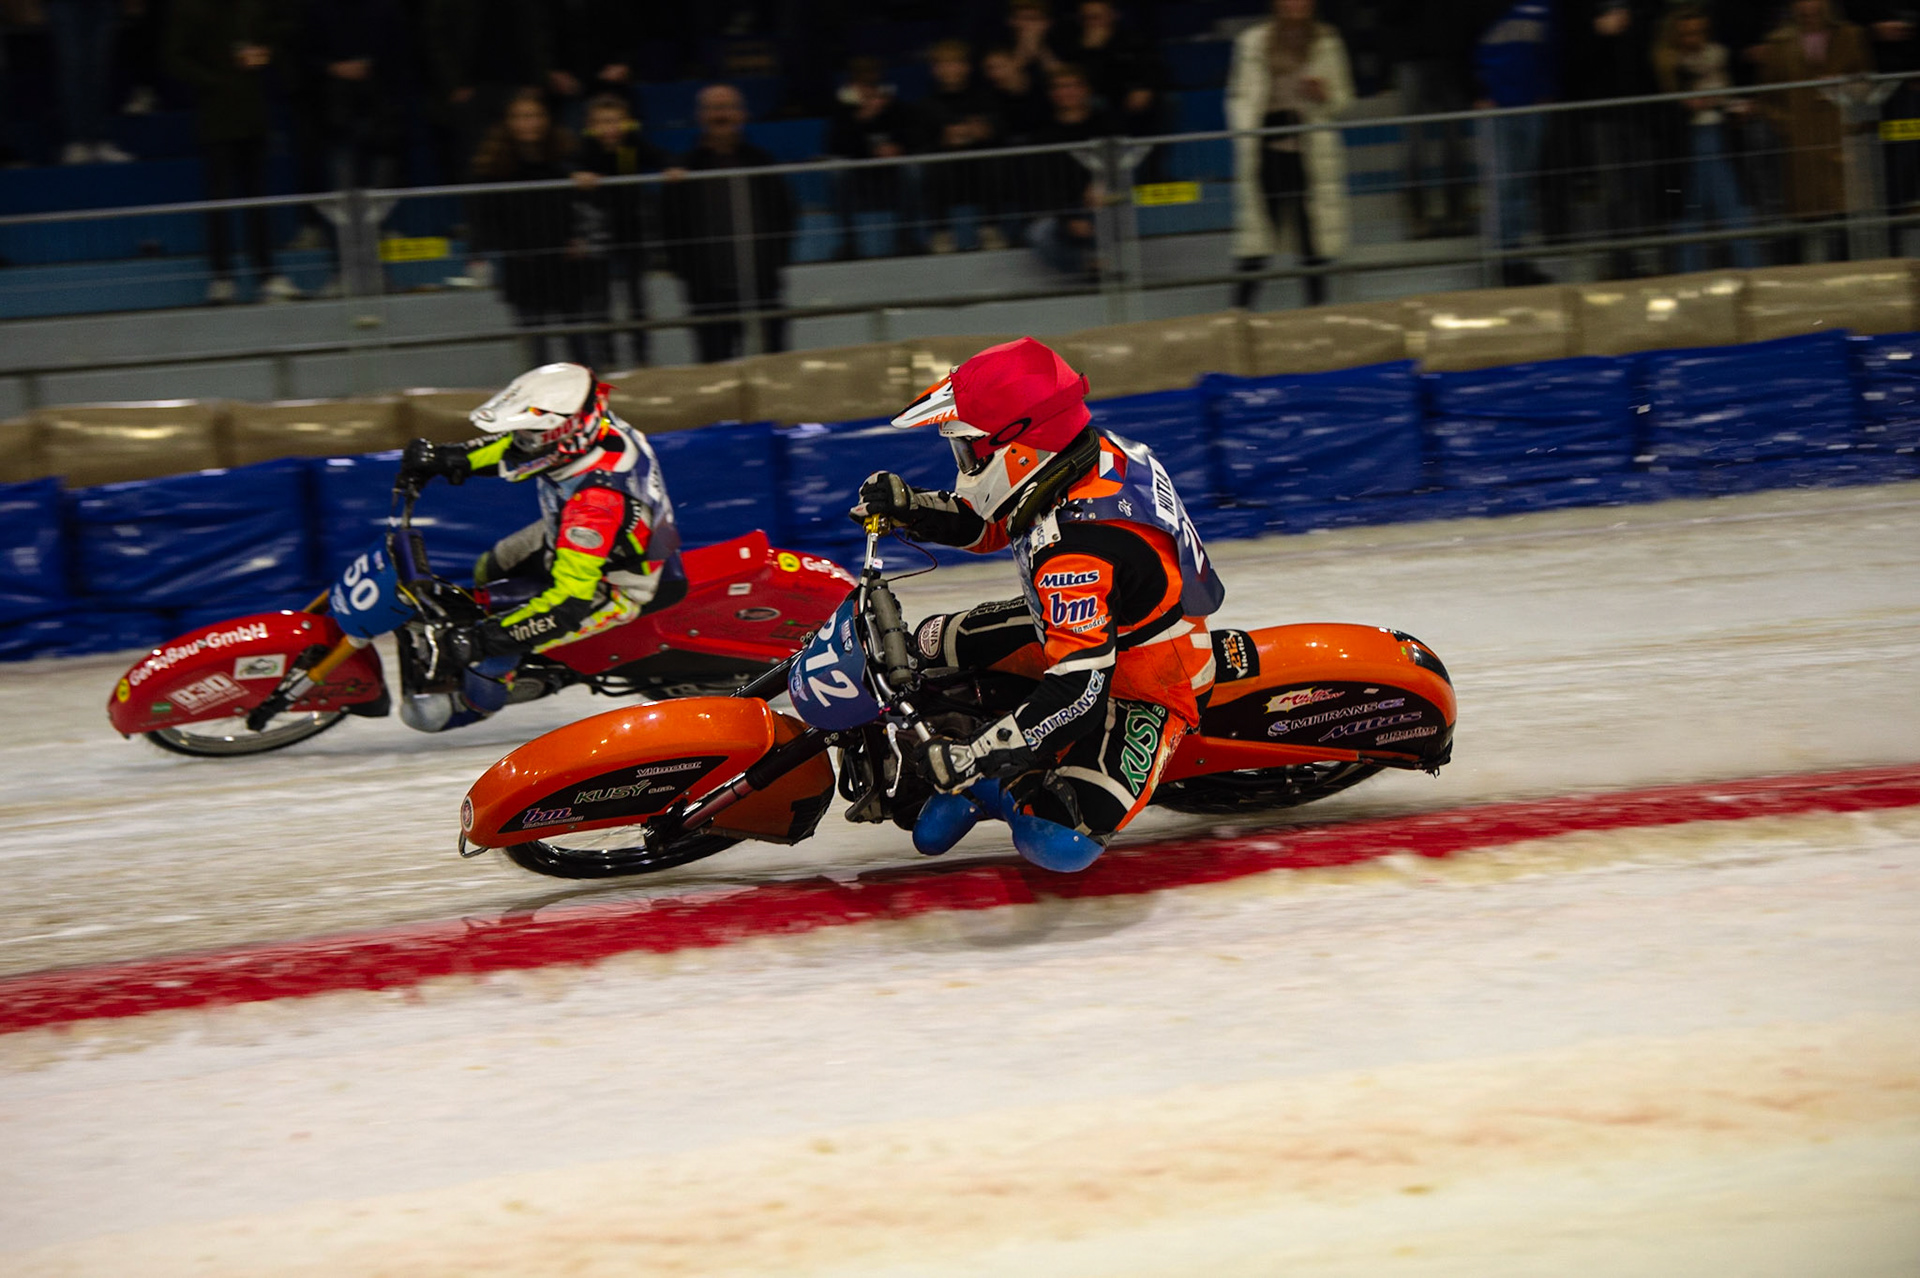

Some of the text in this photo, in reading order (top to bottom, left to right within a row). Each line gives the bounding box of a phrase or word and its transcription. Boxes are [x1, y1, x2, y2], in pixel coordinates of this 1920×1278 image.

[1155, 470, 1176, 516] HUTLA
[343, 553, 379, 611] 50
[1038, 570, 1100, 588] Mitas
[1048, 591, 1099, 627] bm
[1318, 711, 1422, 743] Mitas
[522, 807, 573, 825] bm
